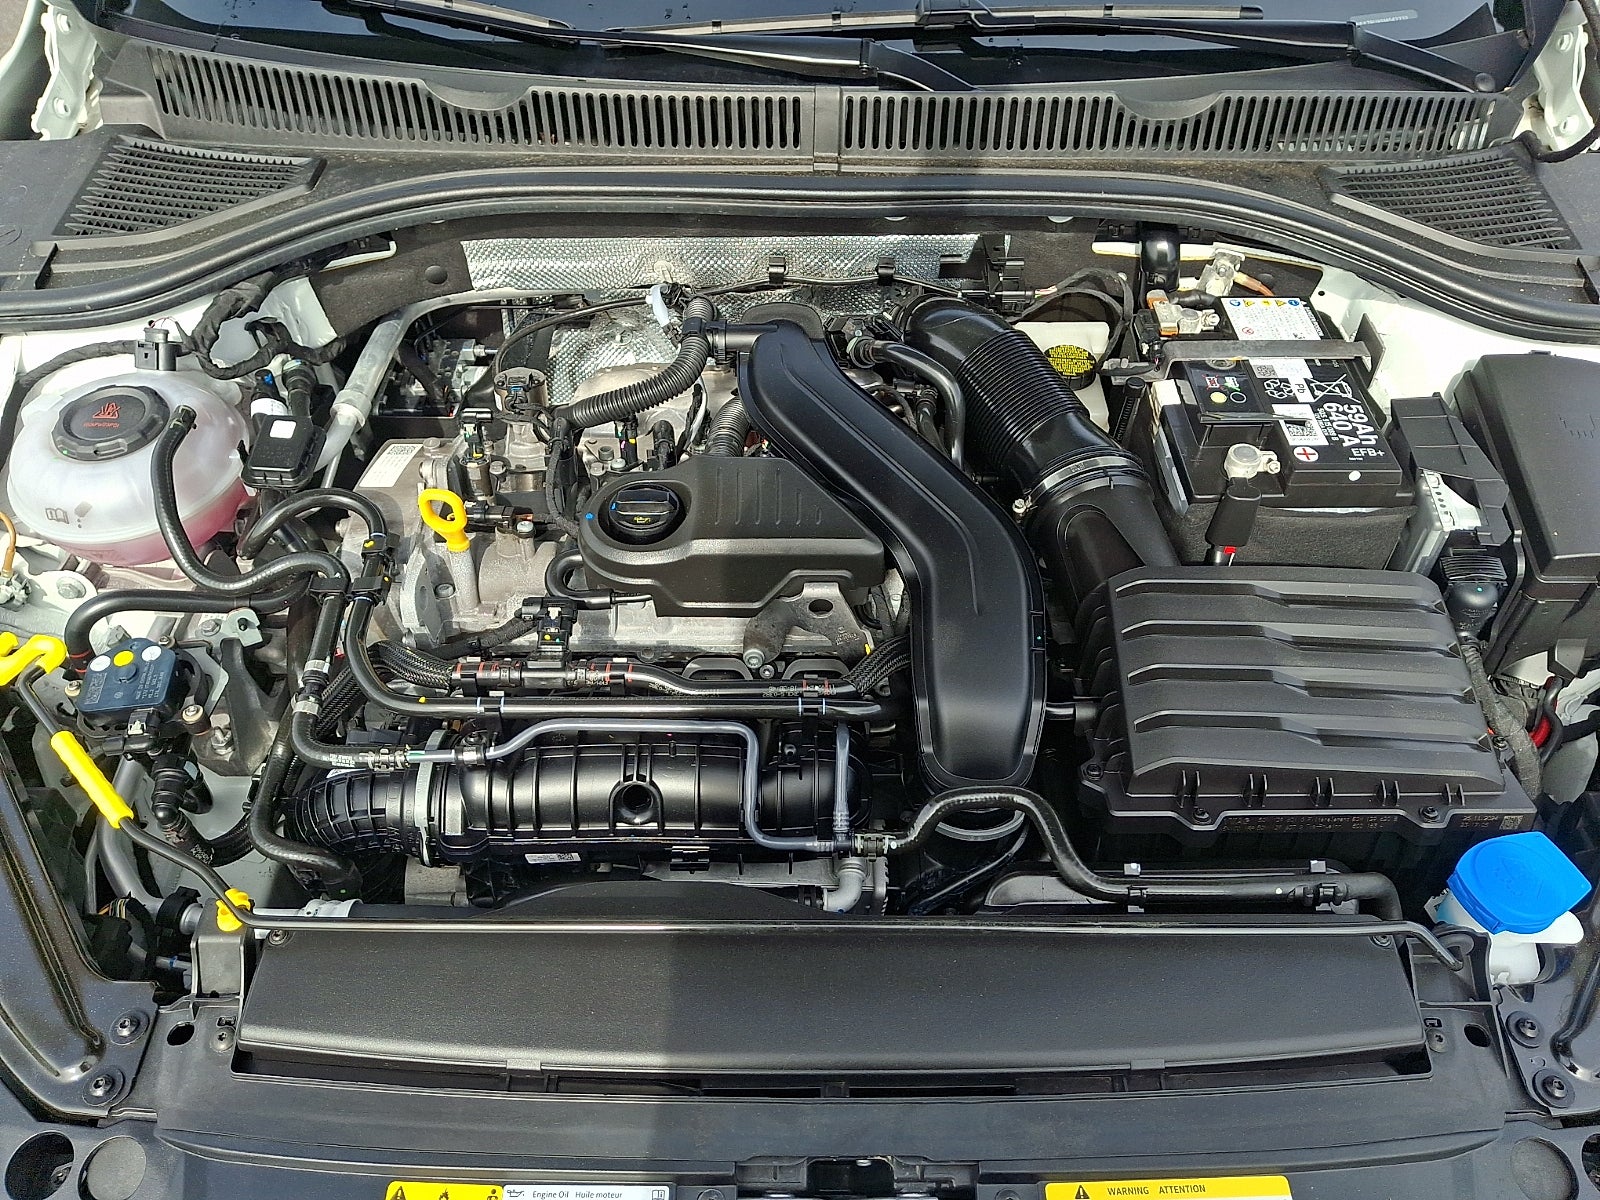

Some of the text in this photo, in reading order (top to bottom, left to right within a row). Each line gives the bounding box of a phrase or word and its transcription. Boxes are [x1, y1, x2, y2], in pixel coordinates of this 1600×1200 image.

[1295, 383, 1306, 394] Pb
[1323, 402, 1353, 431] 640
[1343, 404, 1378, 445] 59Ah
[1337, 433, 1361, 447] A
[1351, 447, 1385, 457] EFB+
[532, 1190, 622, 1200] Engine Oil Huile moteur
[1107, 1184, 1206, 1196] WARNING ATTENTION
